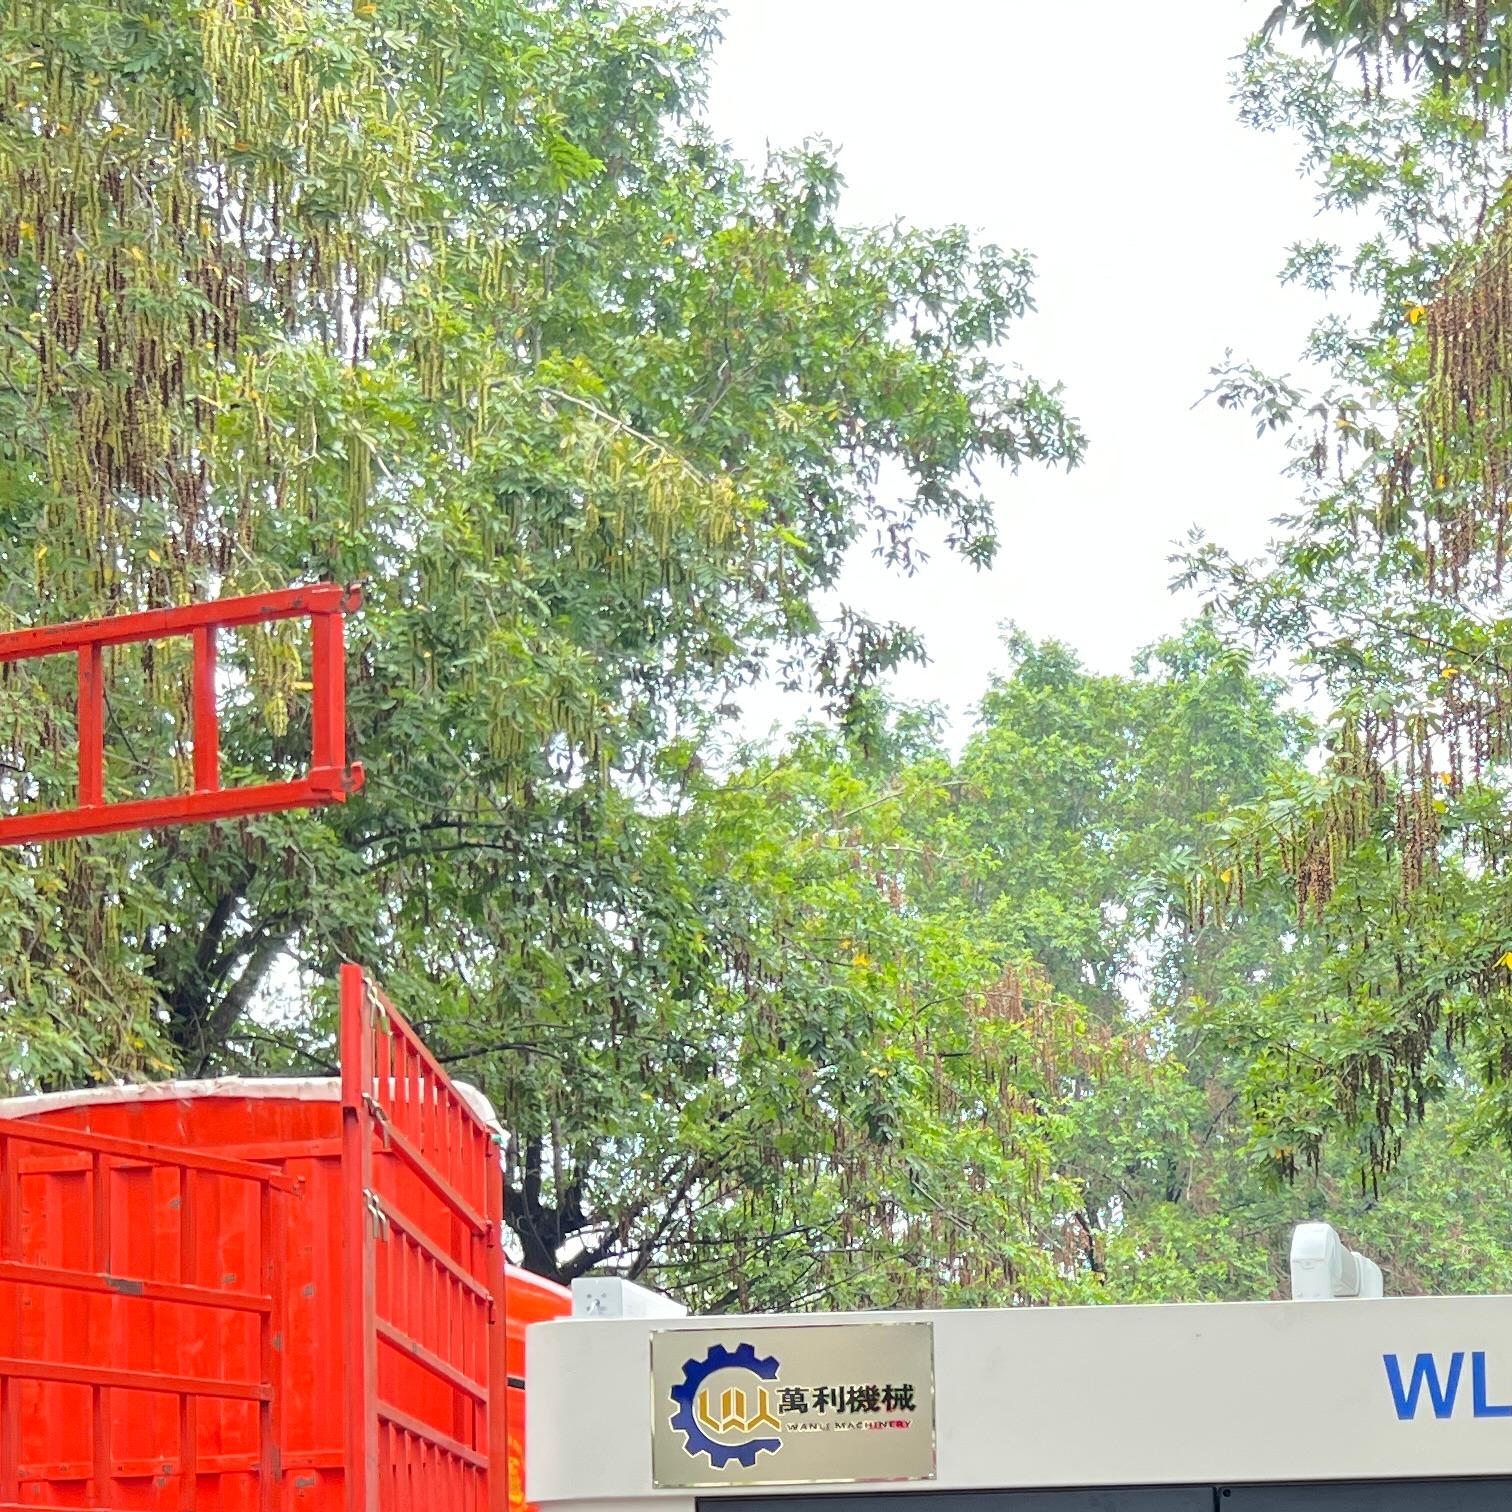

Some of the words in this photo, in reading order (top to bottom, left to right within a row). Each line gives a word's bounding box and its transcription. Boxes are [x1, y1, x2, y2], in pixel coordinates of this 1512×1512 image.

[777, 1384, 916, 1414] 萬利機械
[786, 1422, 830, 1432] WANLI
[834, 1419, 912, 1431] MACHINERY
